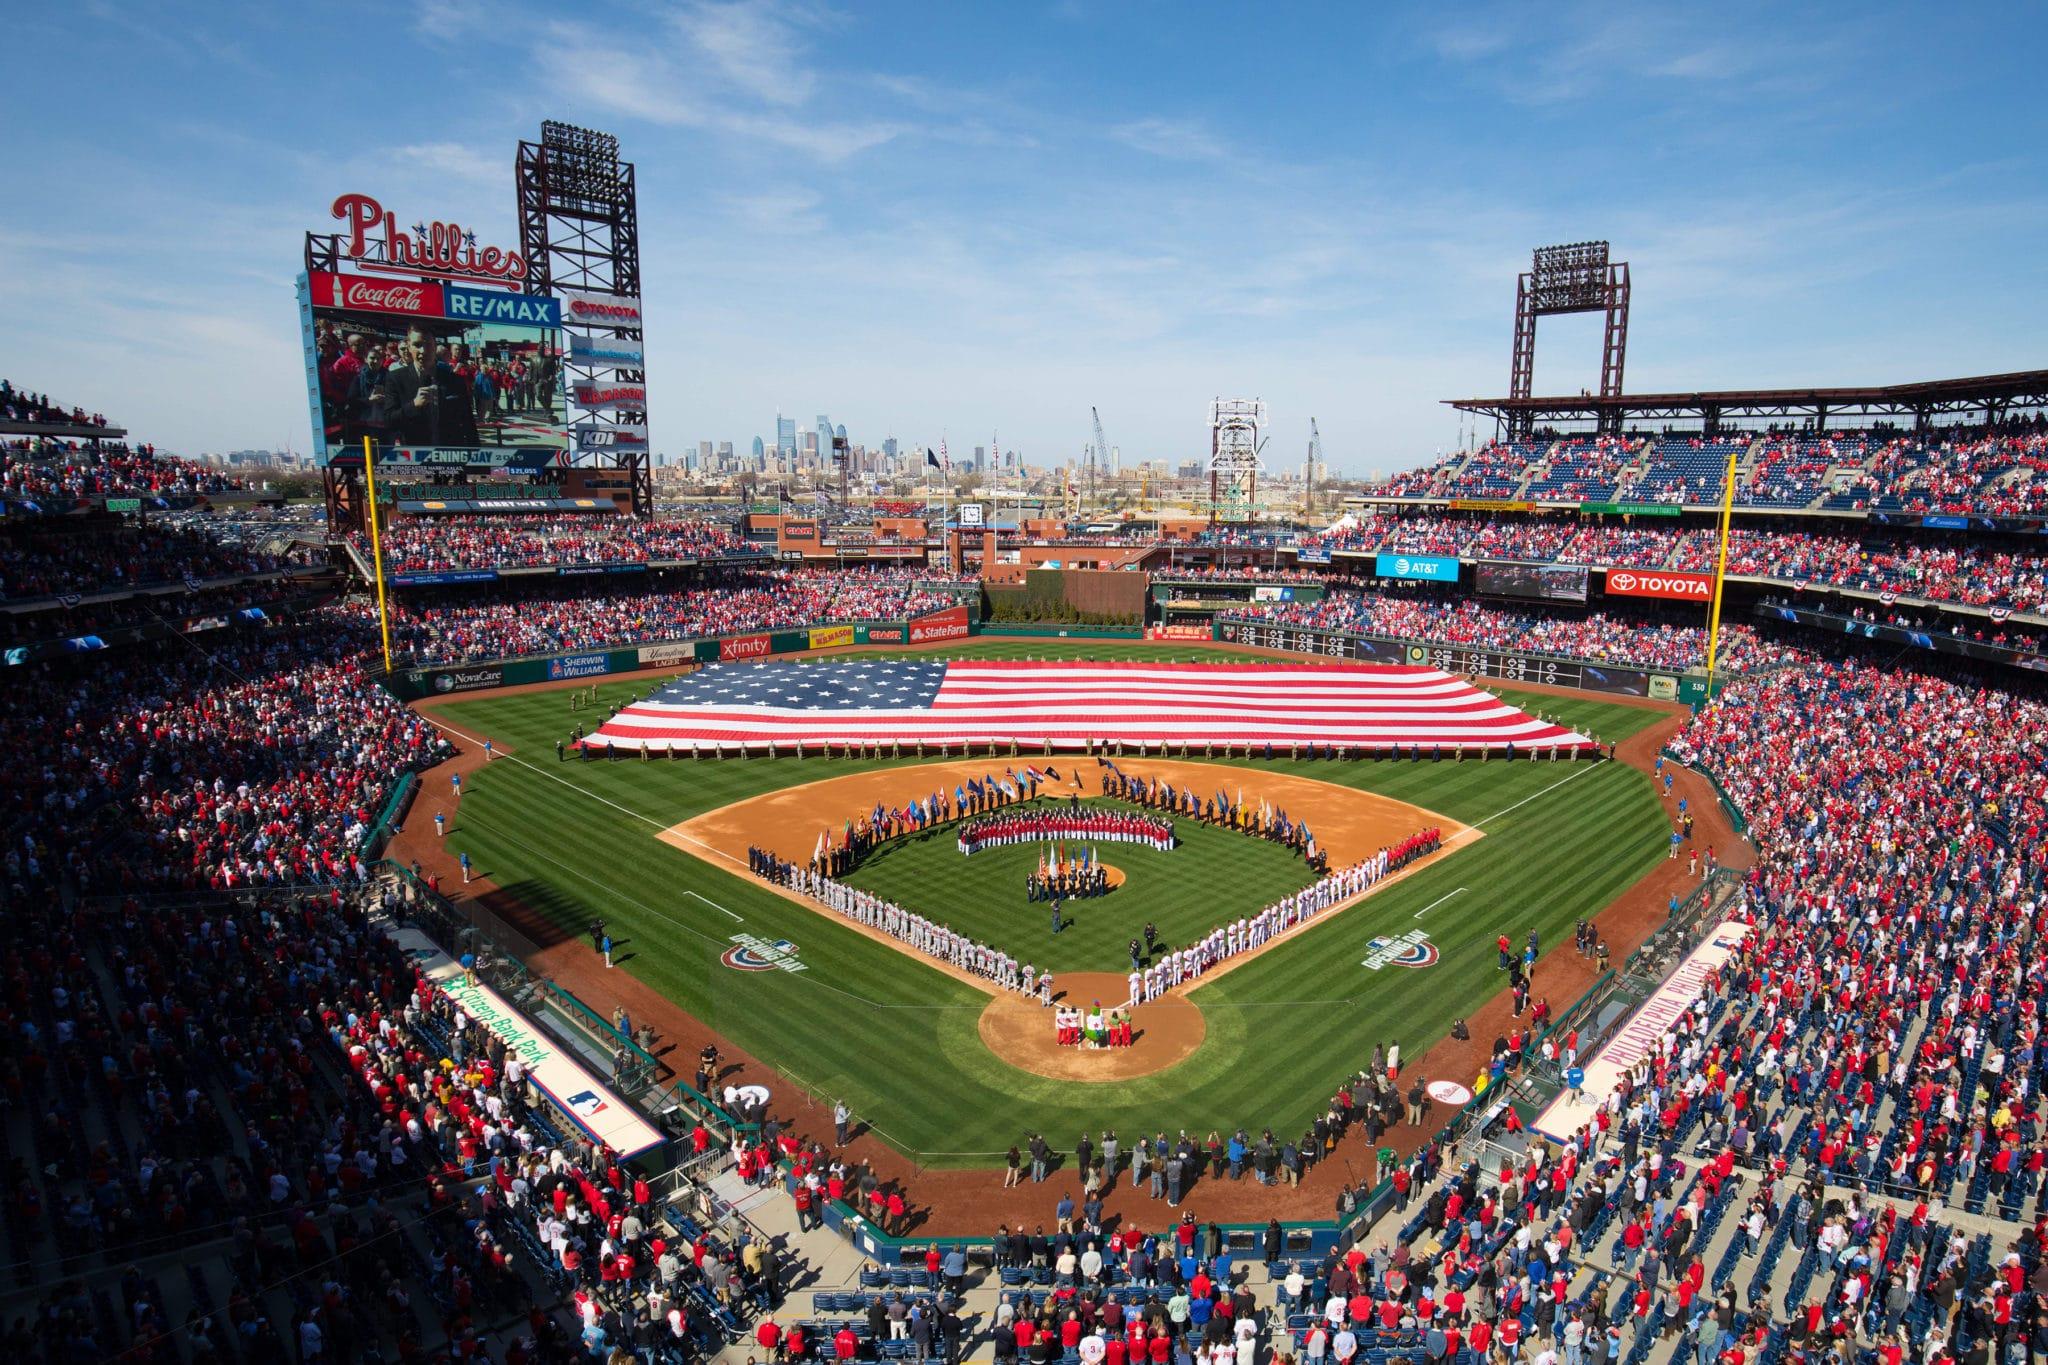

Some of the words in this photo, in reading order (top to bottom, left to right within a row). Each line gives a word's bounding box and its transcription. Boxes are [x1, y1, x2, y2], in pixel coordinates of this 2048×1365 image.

[331, 193, 528, 279] Phillies
[348, 282, 423, 311] Coca-Cola
[451, 294, 550, 323] RE/MAX
[588, 303, 640, 319] TOYOTA
[397, 482, 473, 499] Citizens
[475, 482, 520, 499] Bank
[523, 483, 562, 499] Park
[479, 500, 516, 508] HARRY
[785, 527, 813, 536] GIANT
[1411, 562, 1439, 574] AT&T
[1640, 578, 1709, 595] TOYOTA
[869, 630, 902, 640] GIANT
[649, 647, 688, 660] Yuengling
[723, 638, 769, 658] xfinity
[564, 656, 604, 667] SHERWIN
[655, 657, 680, 667] LAGER
[454, 671, 501, 684] NovaCare
[1692, 683, 1705, 691] 330
[728, 932, 787, 961] OPENING
[773, 957, 809, 972] DAY
[1361, 940, 1414, 970] OPENING
[1402, 928, 1430, 944] DAY
[460, 987, 499, 1027] Citizens
[492, 1014, 525, 1050] Bank
[516, 1038, 550, 1064] Park
[1602, 996, 1685, 1067] PHILADELPHIA
[1090, 1345, 1096, 1354] 3
